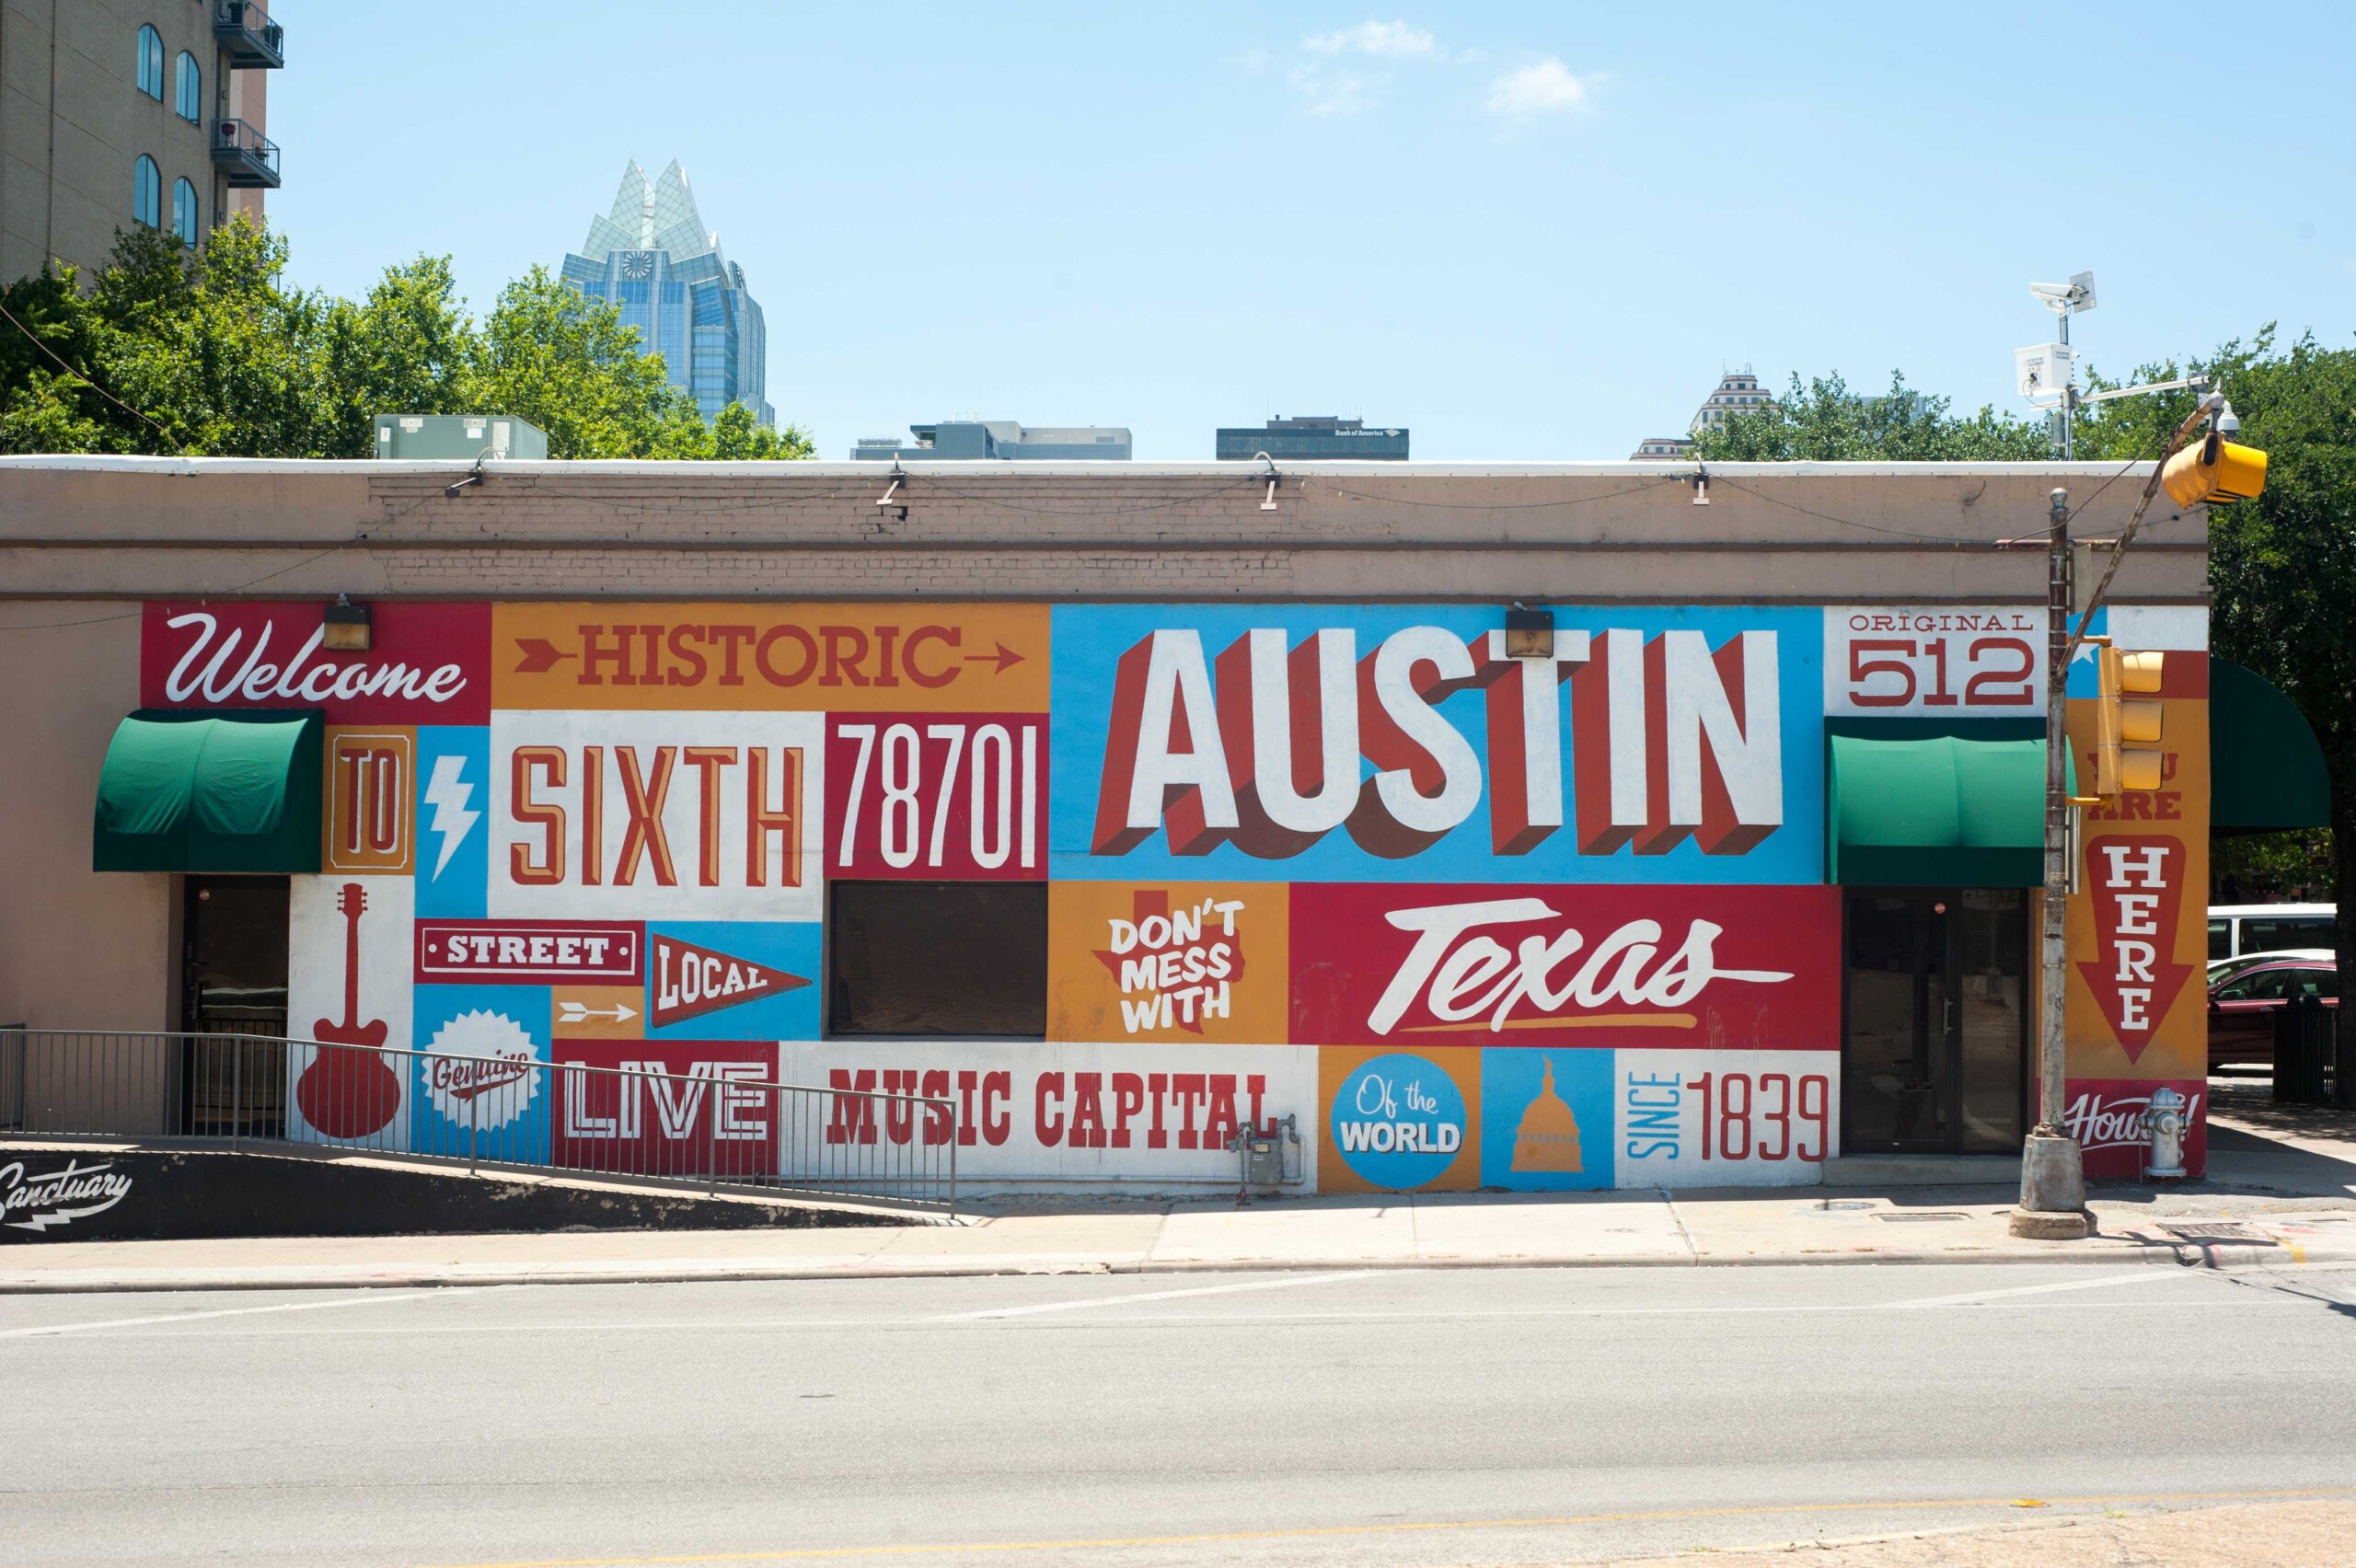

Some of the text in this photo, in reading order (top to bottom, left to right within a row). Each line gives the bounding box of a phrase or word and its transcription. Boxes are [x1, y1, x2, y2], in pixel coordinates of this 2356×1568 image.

[166, 613, 466, 702] Welcome
[577, 624, 962, 688] HISTORIC
[1849, 615, 2034, 632] ORIGINAL
[1849, 638, 2034, 707] 512
[1091, 626, 1783, 858] AUSTIN
[341, 748, 399, 854] TO
[511, 745, 803, 886] SIXTH
[837, 723, 1036, 868] 78701
[447, 935, 609, 965] STREET
[1108, 897, 1245, 953] DON'T
[658, 940, 768, 1009] LOCAL
[1121, 943, 1231, 993] MESS
[1368, 898, 1794, 1035] Texas
[1120, 981, 1230, 1033] WITH
[434, 1049, 528, 1090] Genuine
[564, 1060, 768, 1140] LIVE
[1356, 1075, 1439, 1118] Of the
[826, 1068, 1277, 1149] MUSIC CAPITAL
[1340, 1123, 1461, 1154] WORLD
[1627, 1071, 1680, 1159] SINCE
[1687, 1071, 1829, 1162] 1839
[2064, 1093, 2200, 1151] How!
